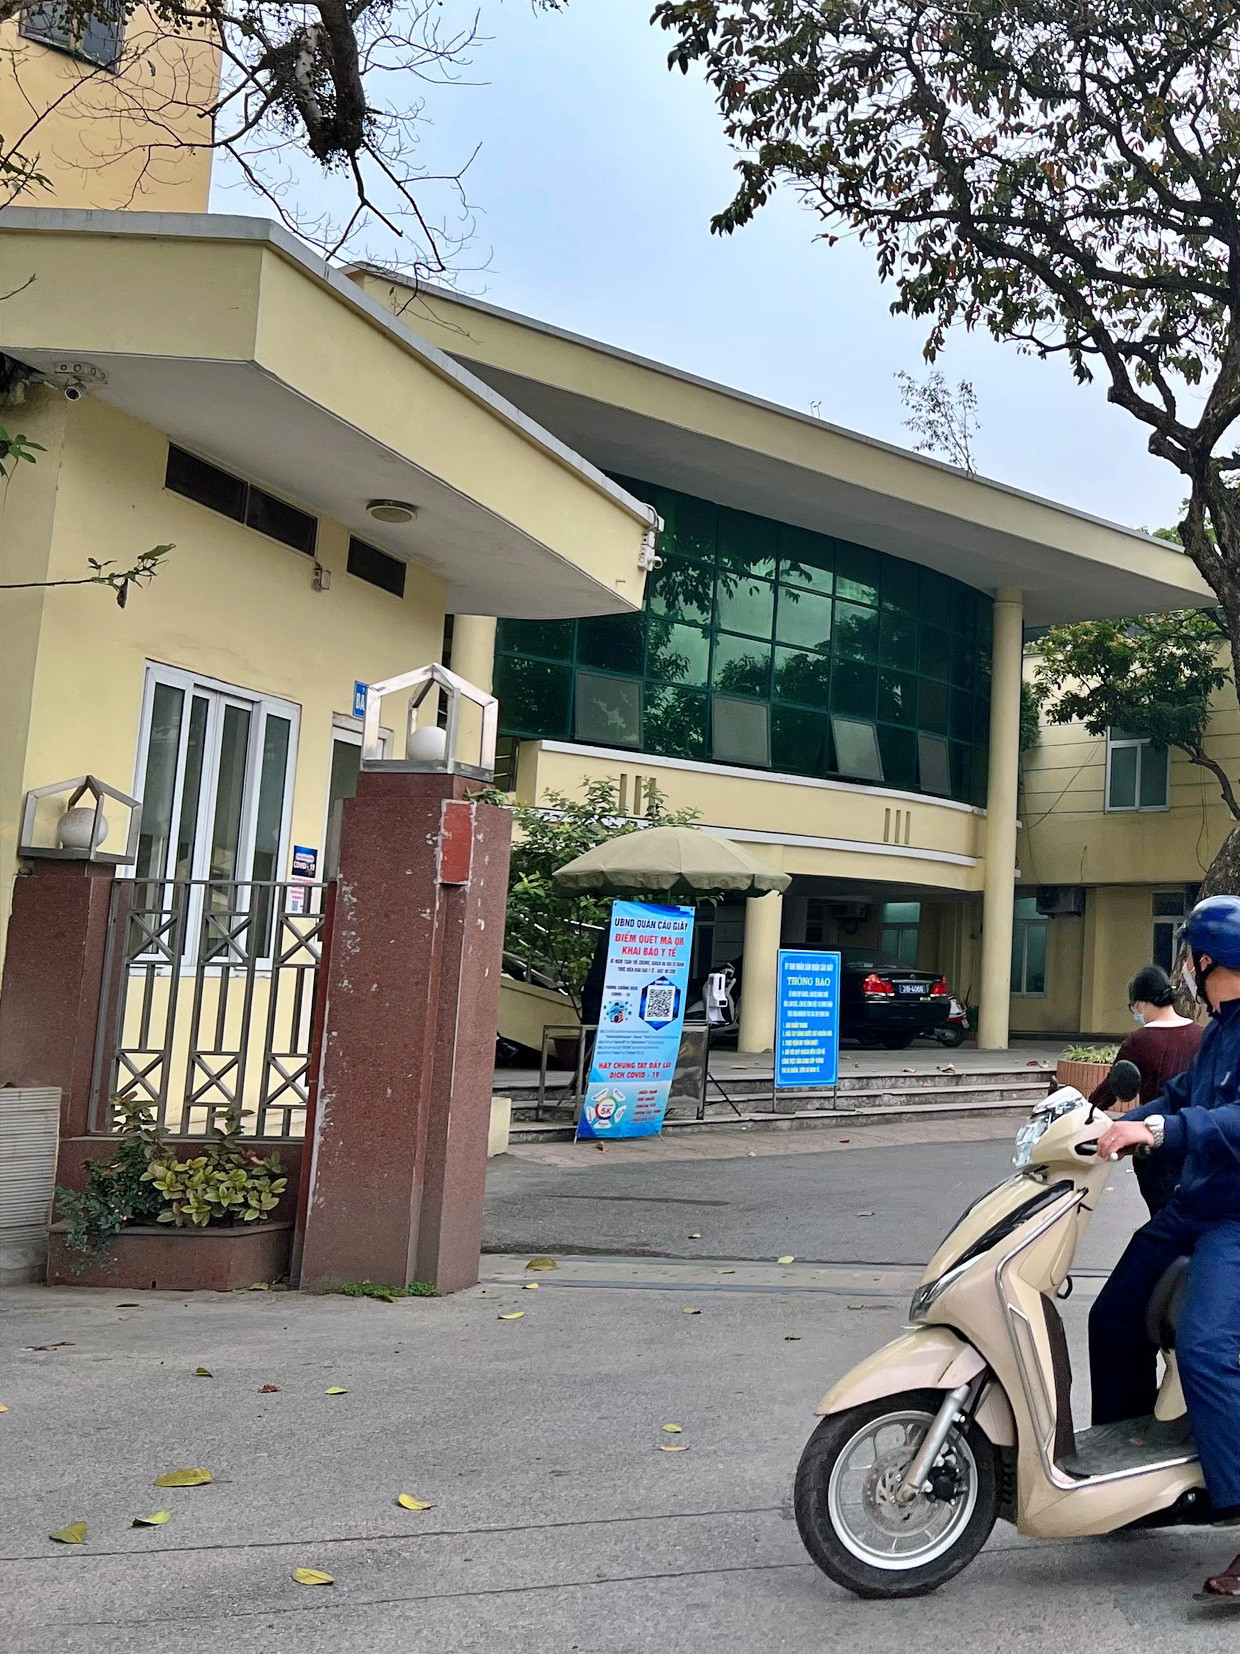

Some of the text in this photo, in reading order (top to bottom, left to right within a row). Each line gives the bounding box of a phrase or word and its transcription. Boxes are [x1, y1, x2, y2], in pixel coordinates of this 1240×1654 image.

[615, 918, 635, 927] UBND
[621, 946, 641, 956] KHAI
[661, 948, 666, 957] Y
[787, 975, 831, 987] THÔNG BÁO
[626, 1071, 646, 1079] COVID
[600, 1107, 613, 1115] 5K
